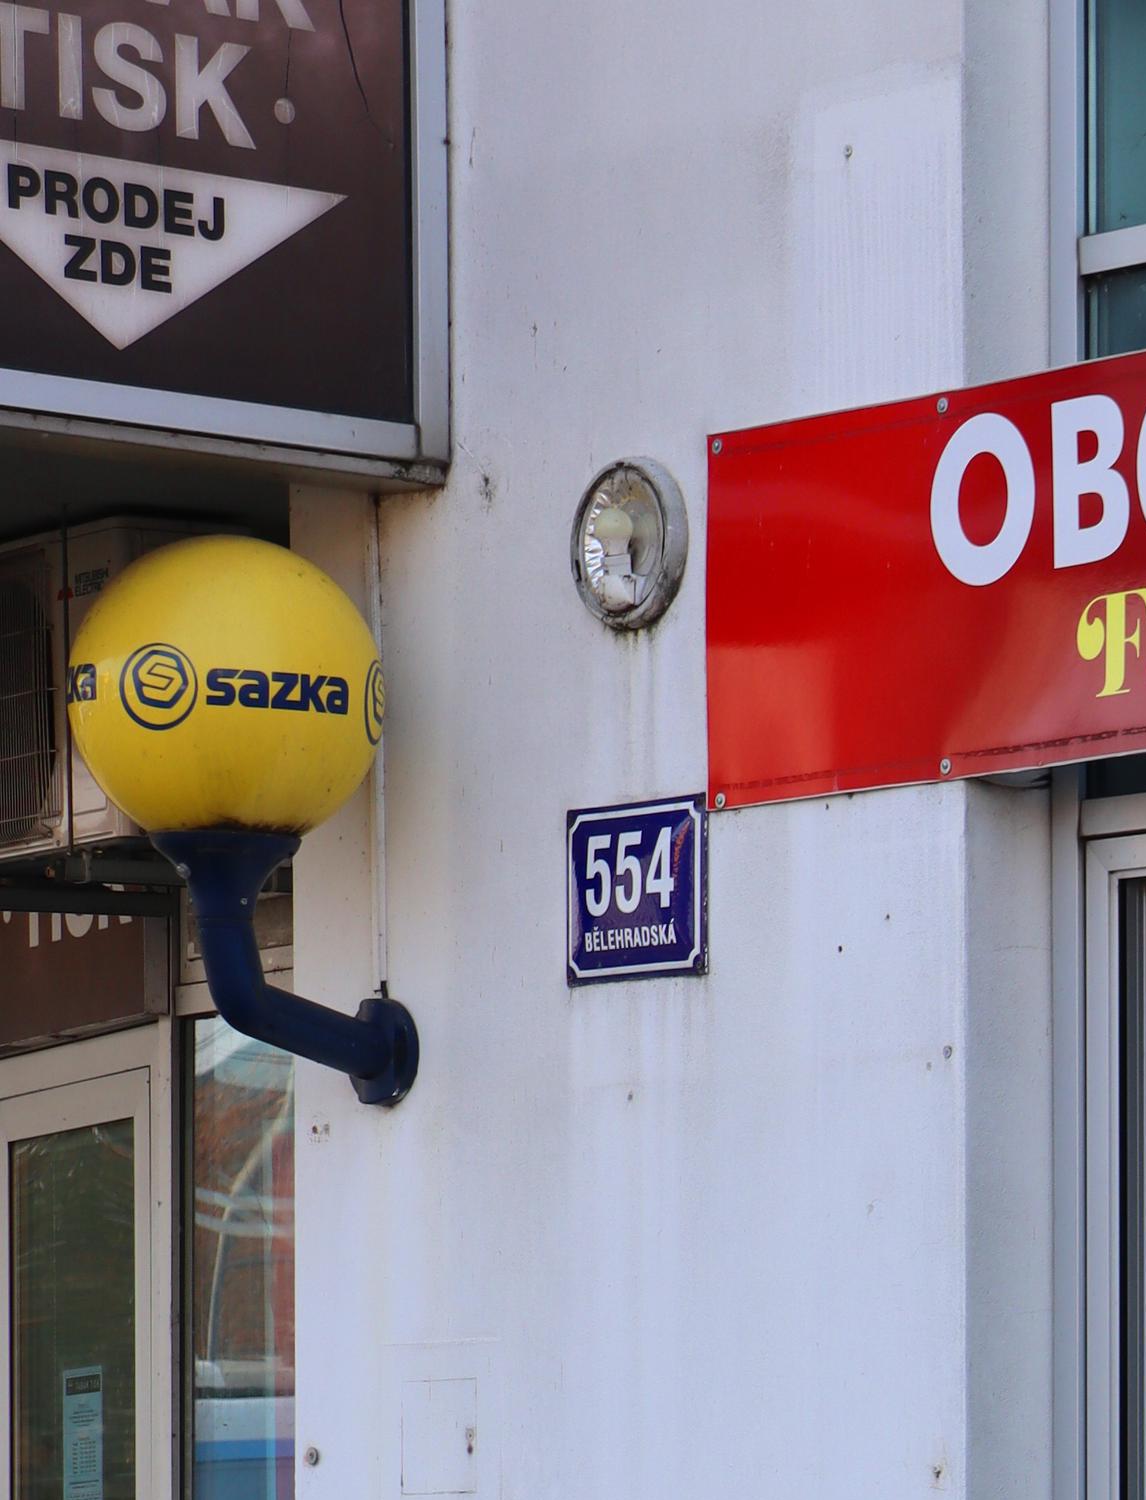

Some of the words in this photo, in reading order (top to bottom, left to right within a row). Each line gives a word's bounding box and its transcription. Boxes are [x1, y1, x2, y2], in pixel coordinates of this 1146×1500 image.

[7, 164, 226, 241] PRODEJ
[64, 234, 172, 294] ZDE
[585, 826, 675, 917] 554
[585, 918, 677, 953] BĚLEHRADSKÁ
